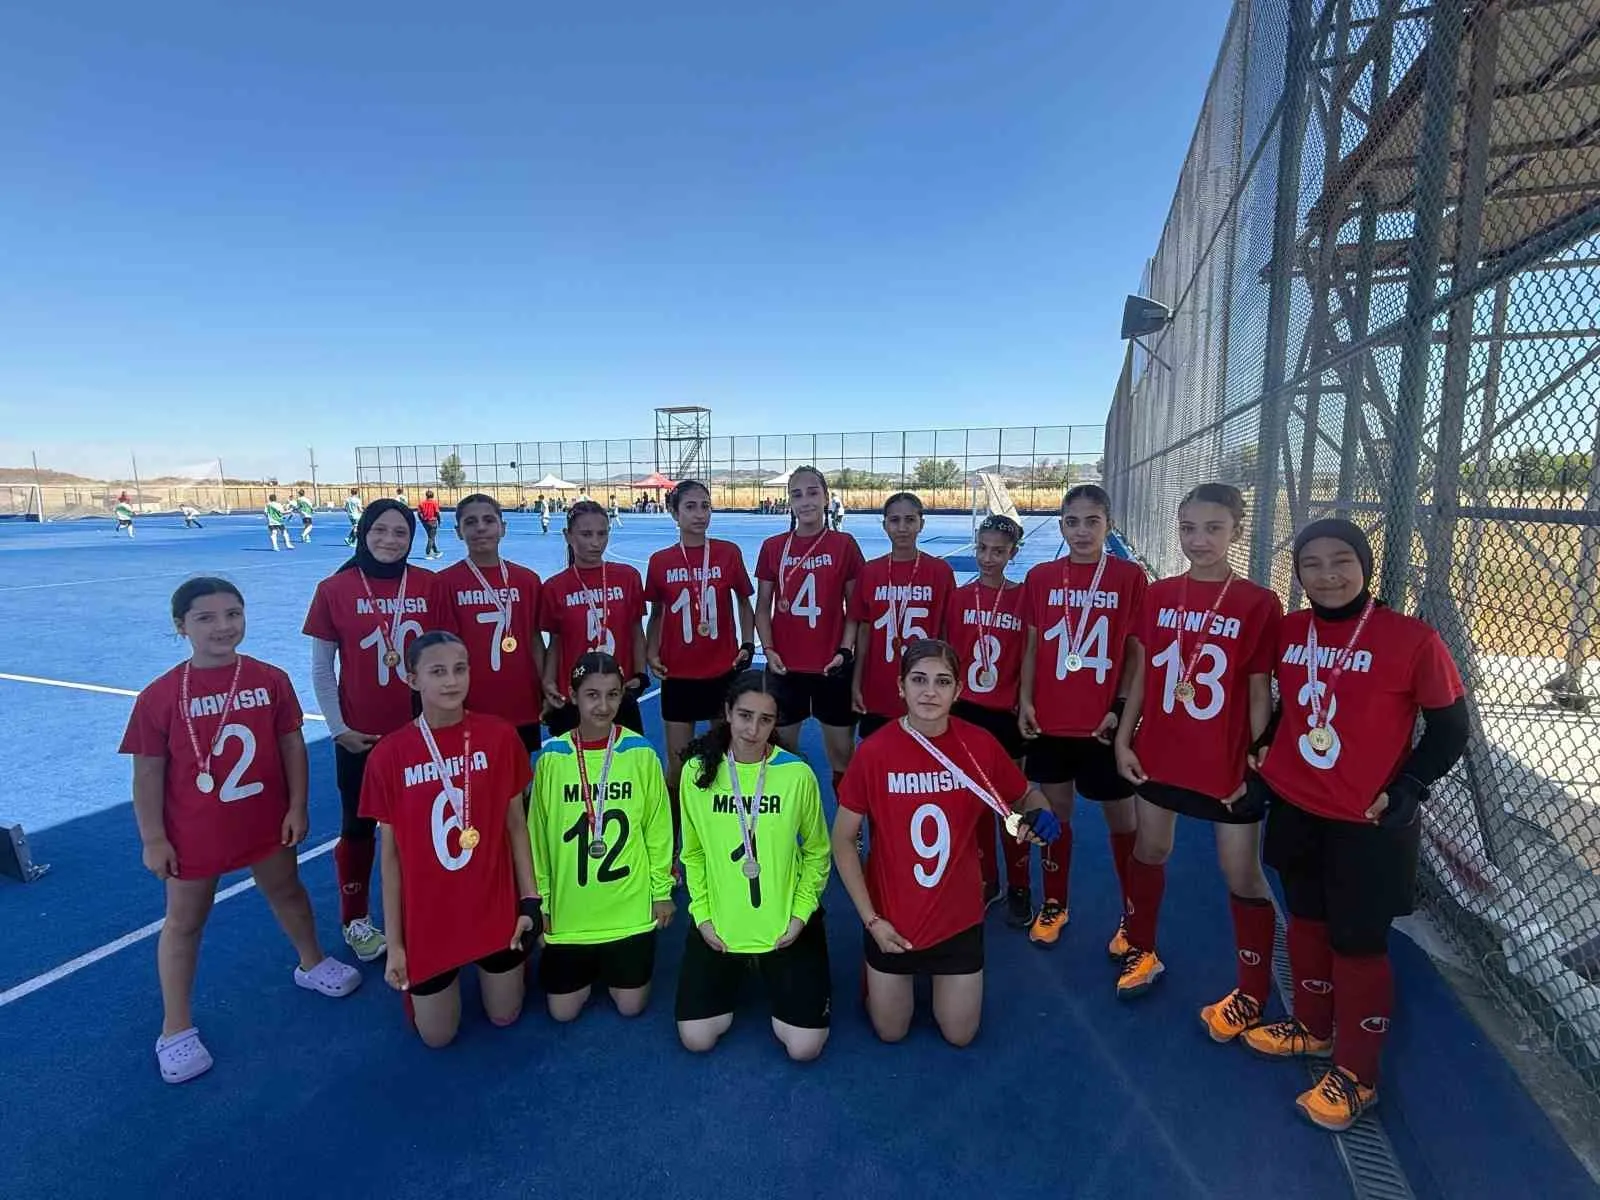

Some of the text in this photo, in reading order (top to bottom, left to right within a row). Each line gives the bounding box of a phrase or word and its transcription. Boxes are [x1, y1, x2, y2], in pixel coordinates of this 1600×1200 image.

[791, 572, 822, 629] 4
[874, 607, 929, 663] 15
[476, 610, 507, 672] 7
[967, 634, 1001, 693] 8
[1043, 615, 1113, 684] 14
[1151, 640, 1227, 720] 13
[212, 723, 257, 803] 2
[431, 786, 474, 871] 6
[562, 808, 631, 887] 12
[910, 803, 951, 888] 9
[730, 828, 762, 909] 1
